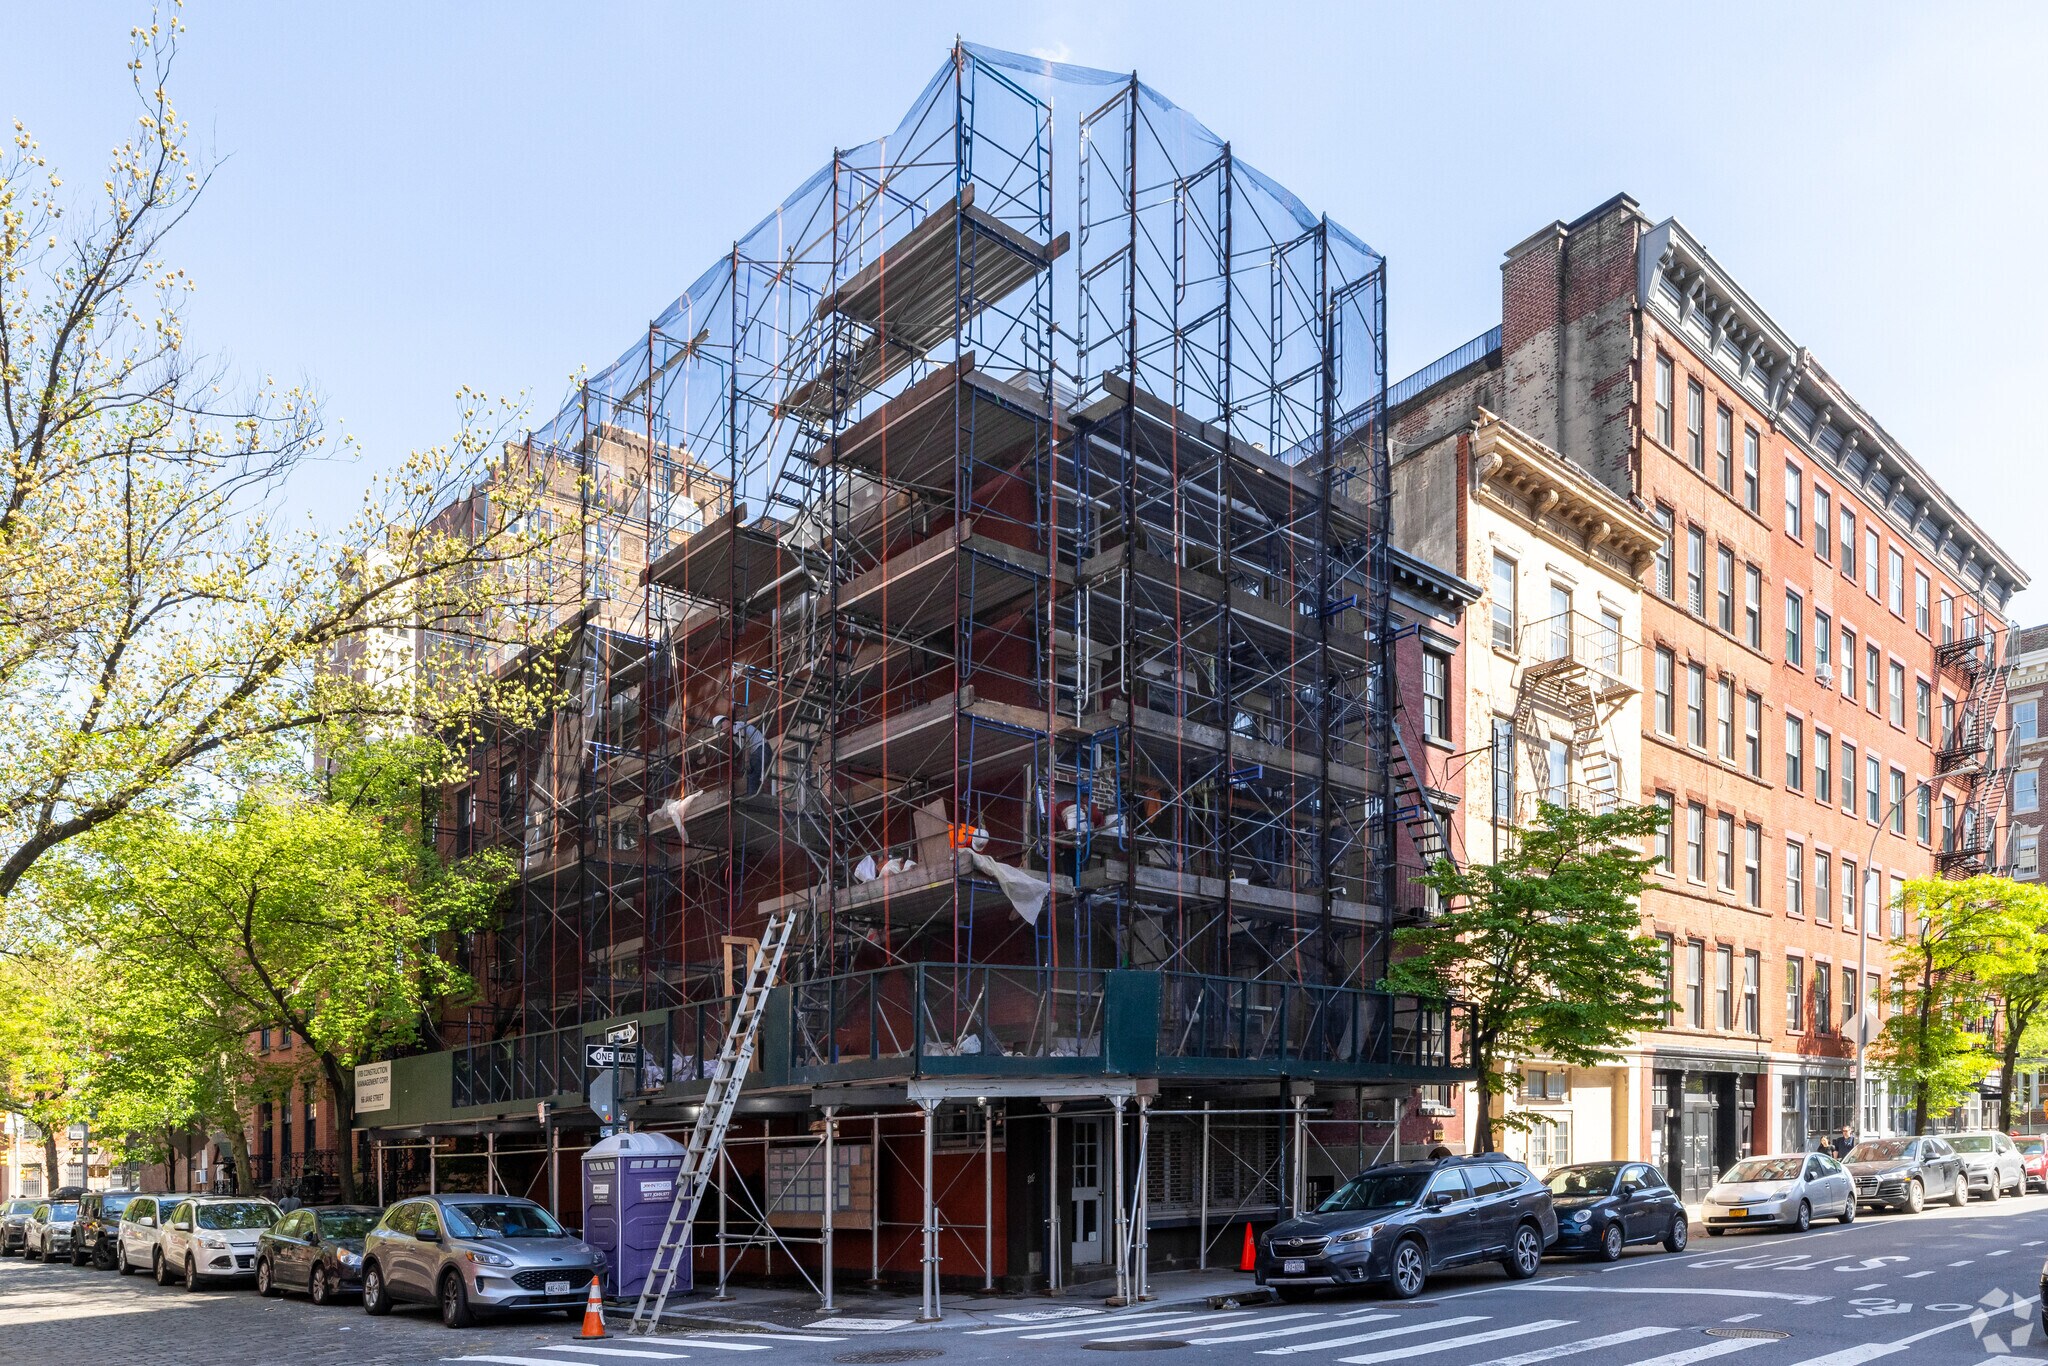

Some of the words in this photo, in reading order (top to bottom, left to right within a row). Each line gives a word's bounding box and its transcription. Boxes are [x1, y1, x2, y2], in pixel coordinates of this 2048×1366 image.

[622, 1029, 633, 1038] WAY
[596, 1052, 612, 1061] ONE
[620, 1053, 636, 1062] WAY
[364, 1066, 387, 1076] CONSTRUCTION
[357, 1077, 379, 1087] MANAGEMENT
